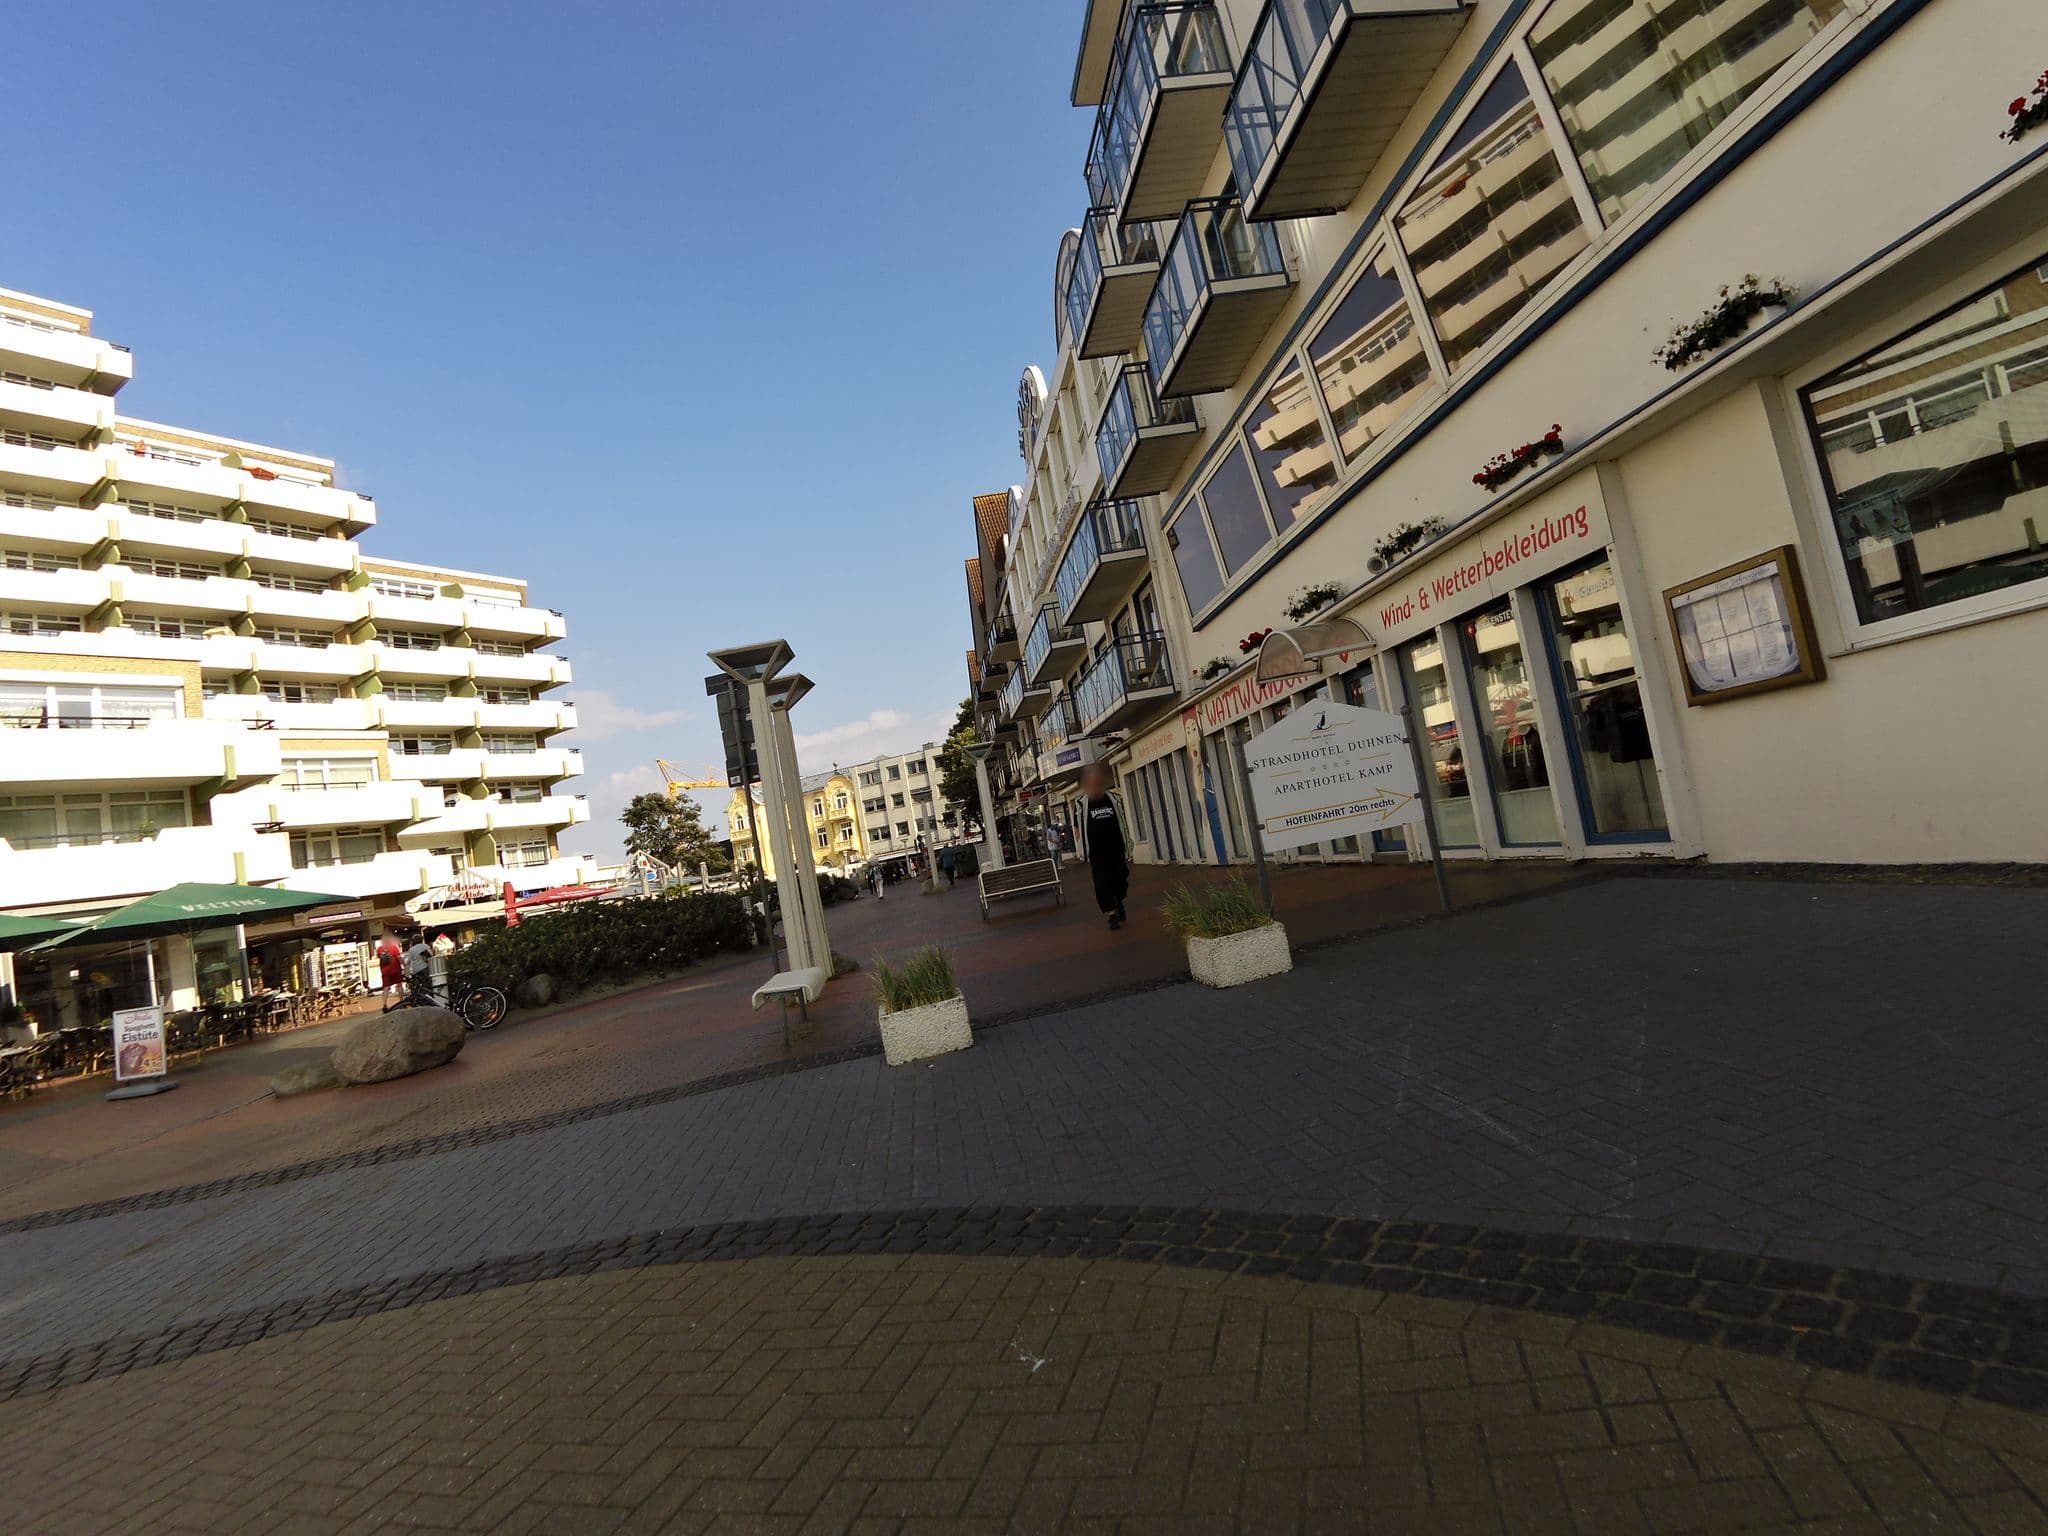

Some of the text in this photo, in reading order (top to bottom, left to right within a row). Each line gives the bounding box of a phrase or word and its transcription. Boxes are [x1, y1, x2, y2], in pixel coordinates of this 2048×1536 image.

[1380, 595, 1415, 630] Wind-
[1418, 586, 1430, 611] &
[1431, 504, 1589, 604] Wetterbekleidung
[1252, 733, 1402, 769] STRANDHOTEL DUHNEN
[1274, 763, 1394, 796] APARTHOTEL KAMP
[1285, 797, 1396, 827] HOFEINFAHRT 20m rechts
[180, 898, 267, 912] VELTINS
[121, 1031, 159, 1043] Eistüte
